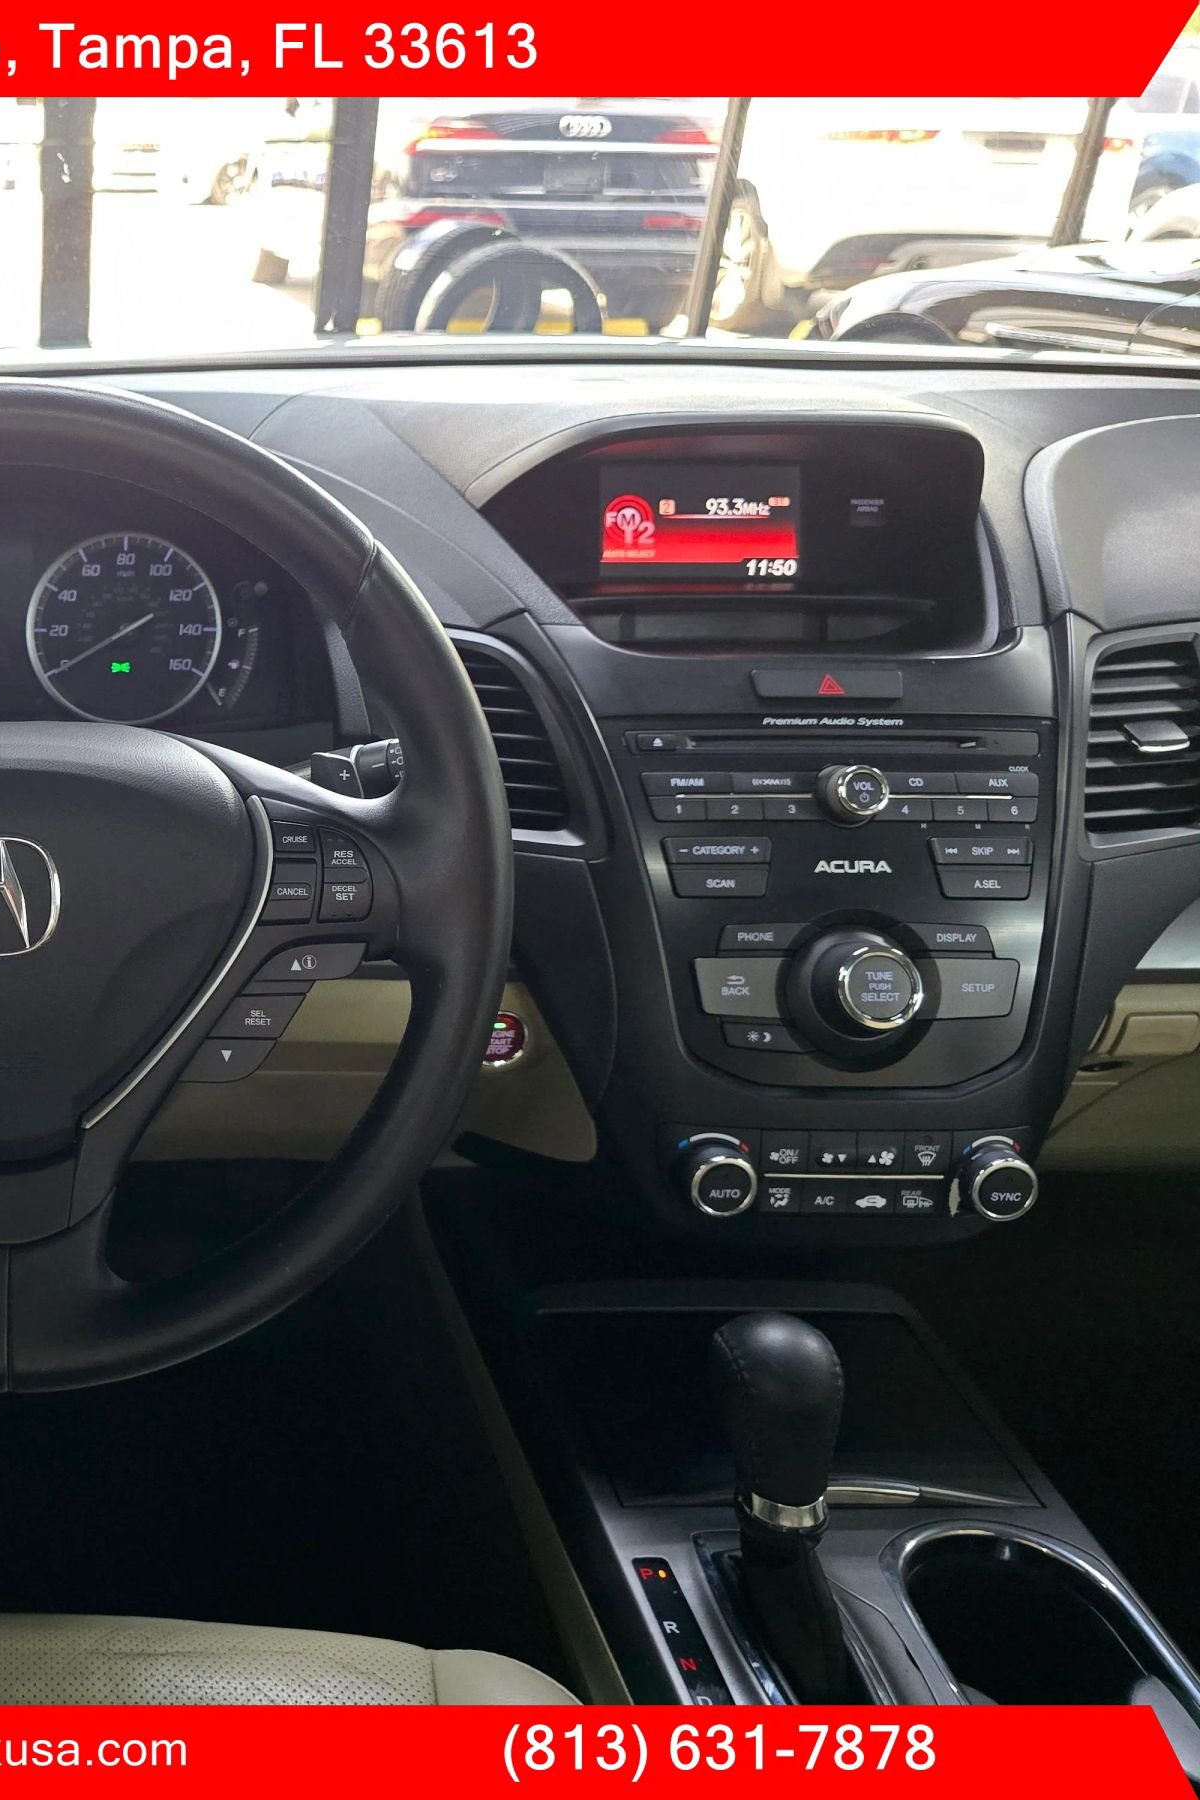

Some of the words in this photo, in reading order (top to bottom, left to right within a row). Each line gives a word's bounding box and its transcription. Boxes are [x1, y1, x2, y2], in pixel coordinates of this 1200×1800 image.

[116, 553, 136, 566] 80
[81, 564, 101, 577] 60
[149, 564, 173, 577] 100
[746, 558, 798, 576] 11:50
[57, 590, 78, 602] 40
[169, 590, 193, 602] 120
[49, 624, 69, 637] 20
[179, 624, 202, 637] 140
[169, 659, 193, 671] 160
[762, 716, 818, 726] Premium
[819, 717, 855, 726] Audio
[857, 717, 904, 727] System
[670, 778, 705, 787] FM/AM
[852, 782, 875, 791] VOL
[908, 778, 924, 787] CD
[988, 778, 1009, 788] AUX
[730, 805, 740, 814] 2
[787, 805, 796, 814] 3
[901, 805, 910, 815] 4
[957, 806, 965, 815] 5
[1010, 806, 1019, 815] 6
[282, 835, 309, 843] CRUISE
[333, 850, 354, 858] RES
[692, 846, 745, 855] CATEGORY
[971, 847, 994, 856] SKIP
[813, 860, 893, 873] ACURA
[706, 879, 736, 888] SCAN
[974, 880, 1001, 889] A.SEL
[276, 887, 309, 896] CANCEL
[335, 892, 355, 901] SET
[737, 932, 774, 941] PHONE
[936, 934, 977, 943] DISPLAY
[865, 971, 894, 981] TUNE
[721, 986, 751, 996] BACK
[961, 983, 996, 992] SETUP
[860, 992, 900, 1002] SELECT
[249, 1009, 267, 1018] SEL
[244, 1018, 272, 1027] RESET
[778, 1157, 800, 1165] OFF
[709, 1188, 742, 1199] AUTO
[768, 1187, 792, 1195] MODE
[814, 1195, 835, 1206] A/C
[990, 1192, 1023, 1202] SYNC
[639, 1568, 653, 1580] P
[662, 1621, 680, 1634] R
[679, 1658, 697, 1671] N
